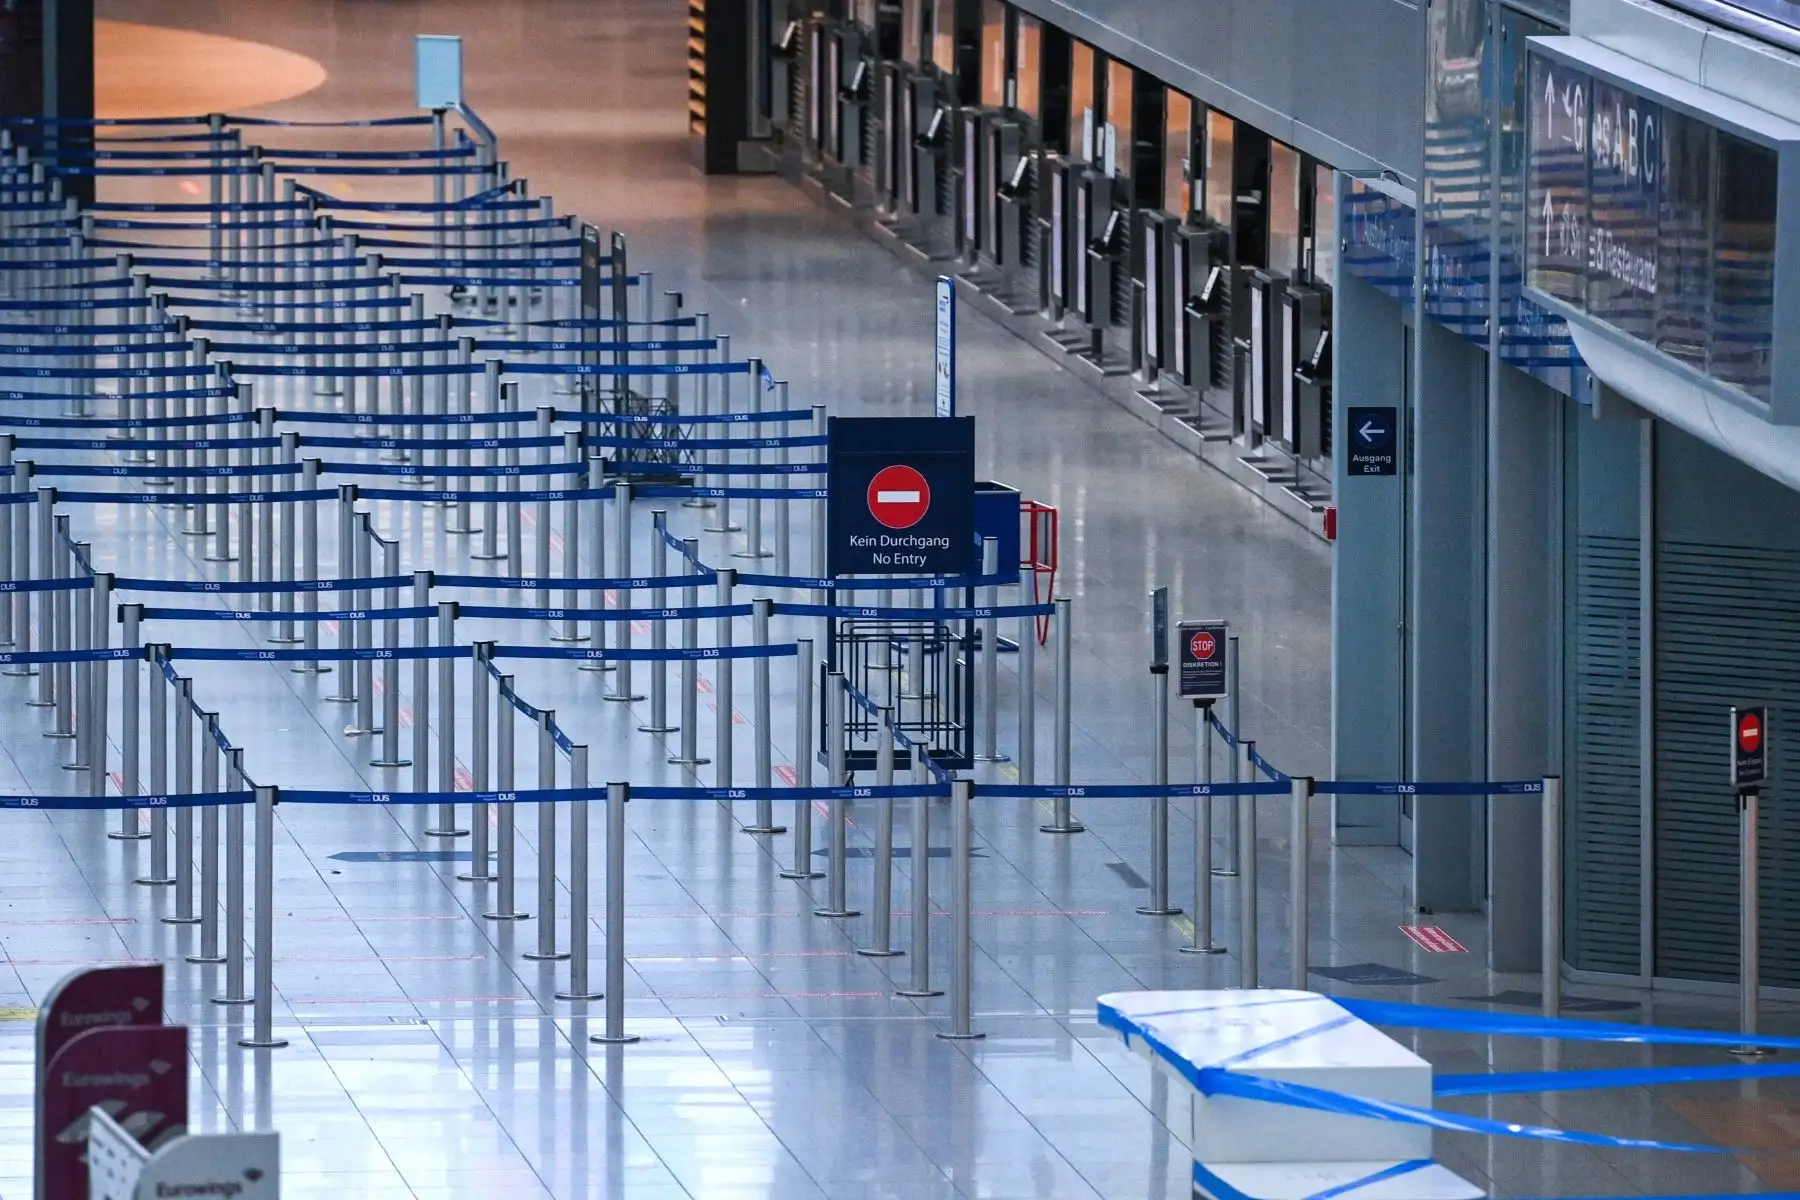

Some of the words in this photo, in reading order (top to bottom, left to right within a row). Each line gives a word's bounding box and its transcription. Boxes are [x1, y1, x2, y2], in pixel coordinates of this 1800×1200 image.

[1352, 454, 1392, 463] Ausgang
[1364, 465, 1380, 473] Exit
[850, 535, 877, 547] Kein
[880, 535, 950, 549] Durchgang
[873, 553, 890, 565] No
[894, 553, 927, 567] Entry
[1192, 640, 1214, 651] STOP
[1398, 785, 1415, 793] DUS
[150, 797, 167, 805] DUS
[61, 1071, 149, 1089] Eurowings
[156, 1181, 242, 1199] Eurowings
